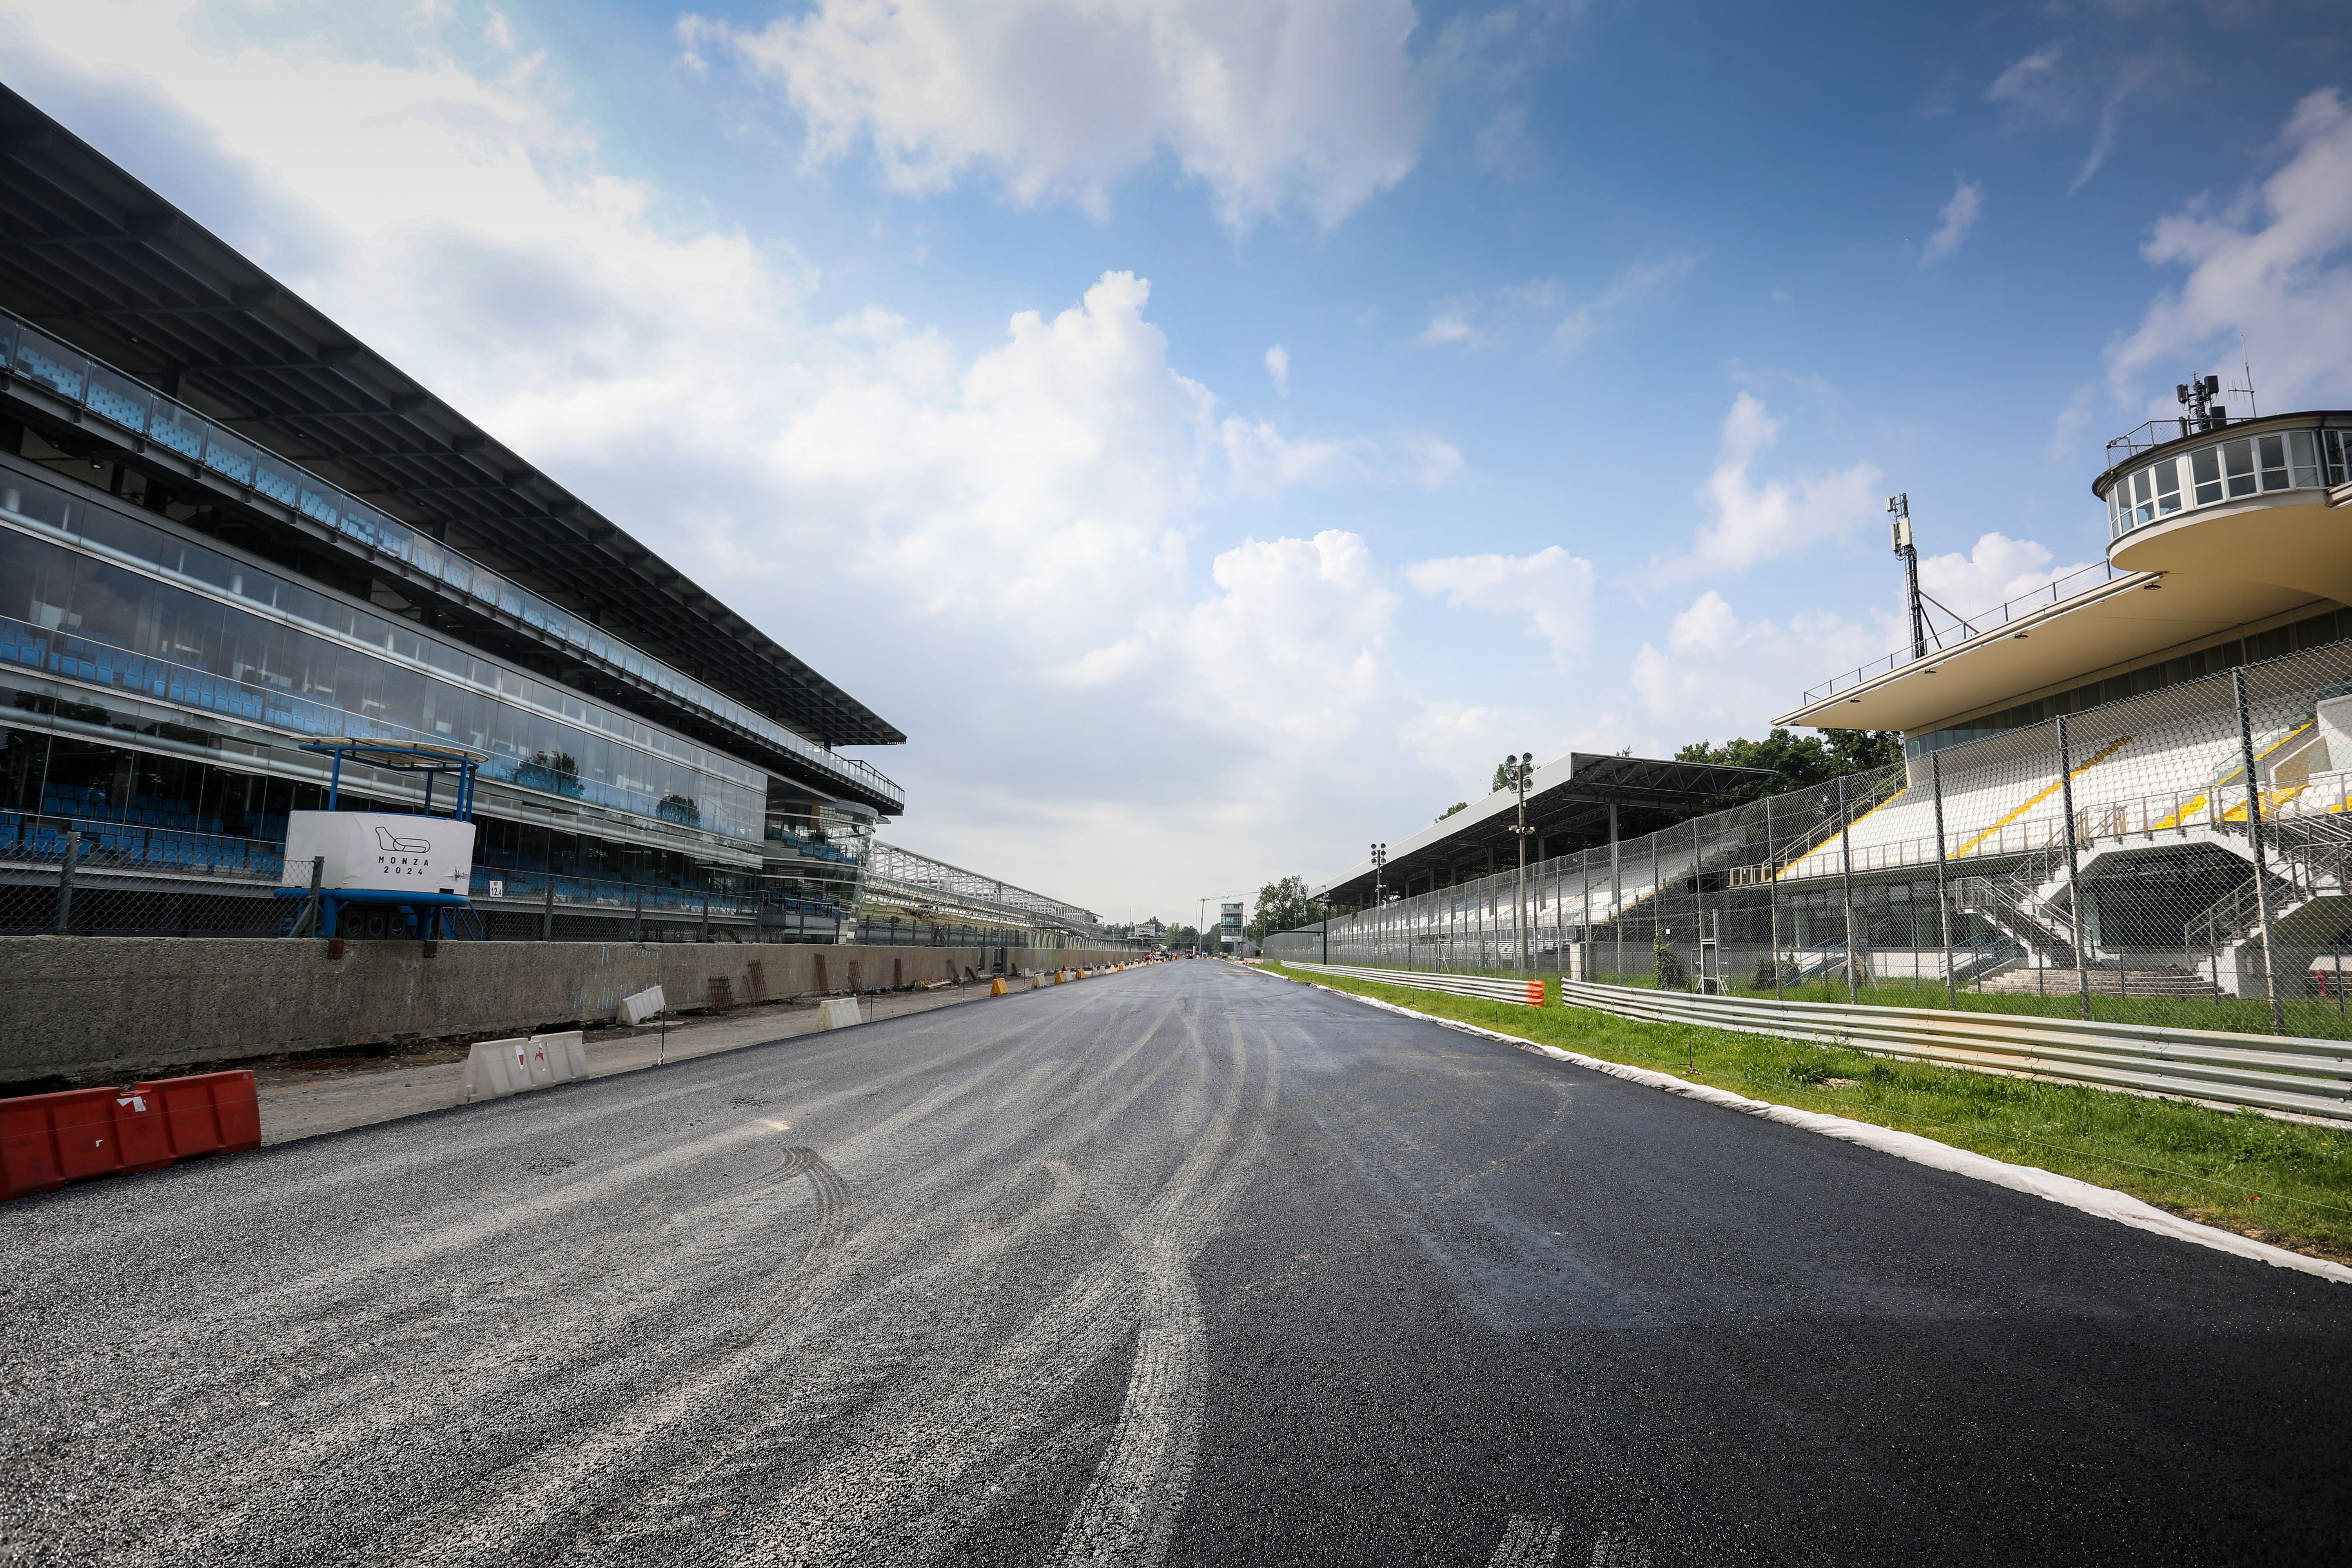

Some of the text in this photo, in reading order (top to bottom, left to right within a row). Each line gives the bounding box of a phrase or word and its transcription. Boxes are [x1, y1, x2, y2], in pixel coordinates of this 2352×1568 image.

[378, 856, 428, 866] MONZA
[384, 866, 423, 875] 2024
[491, 887, 502, 896] 12.4
